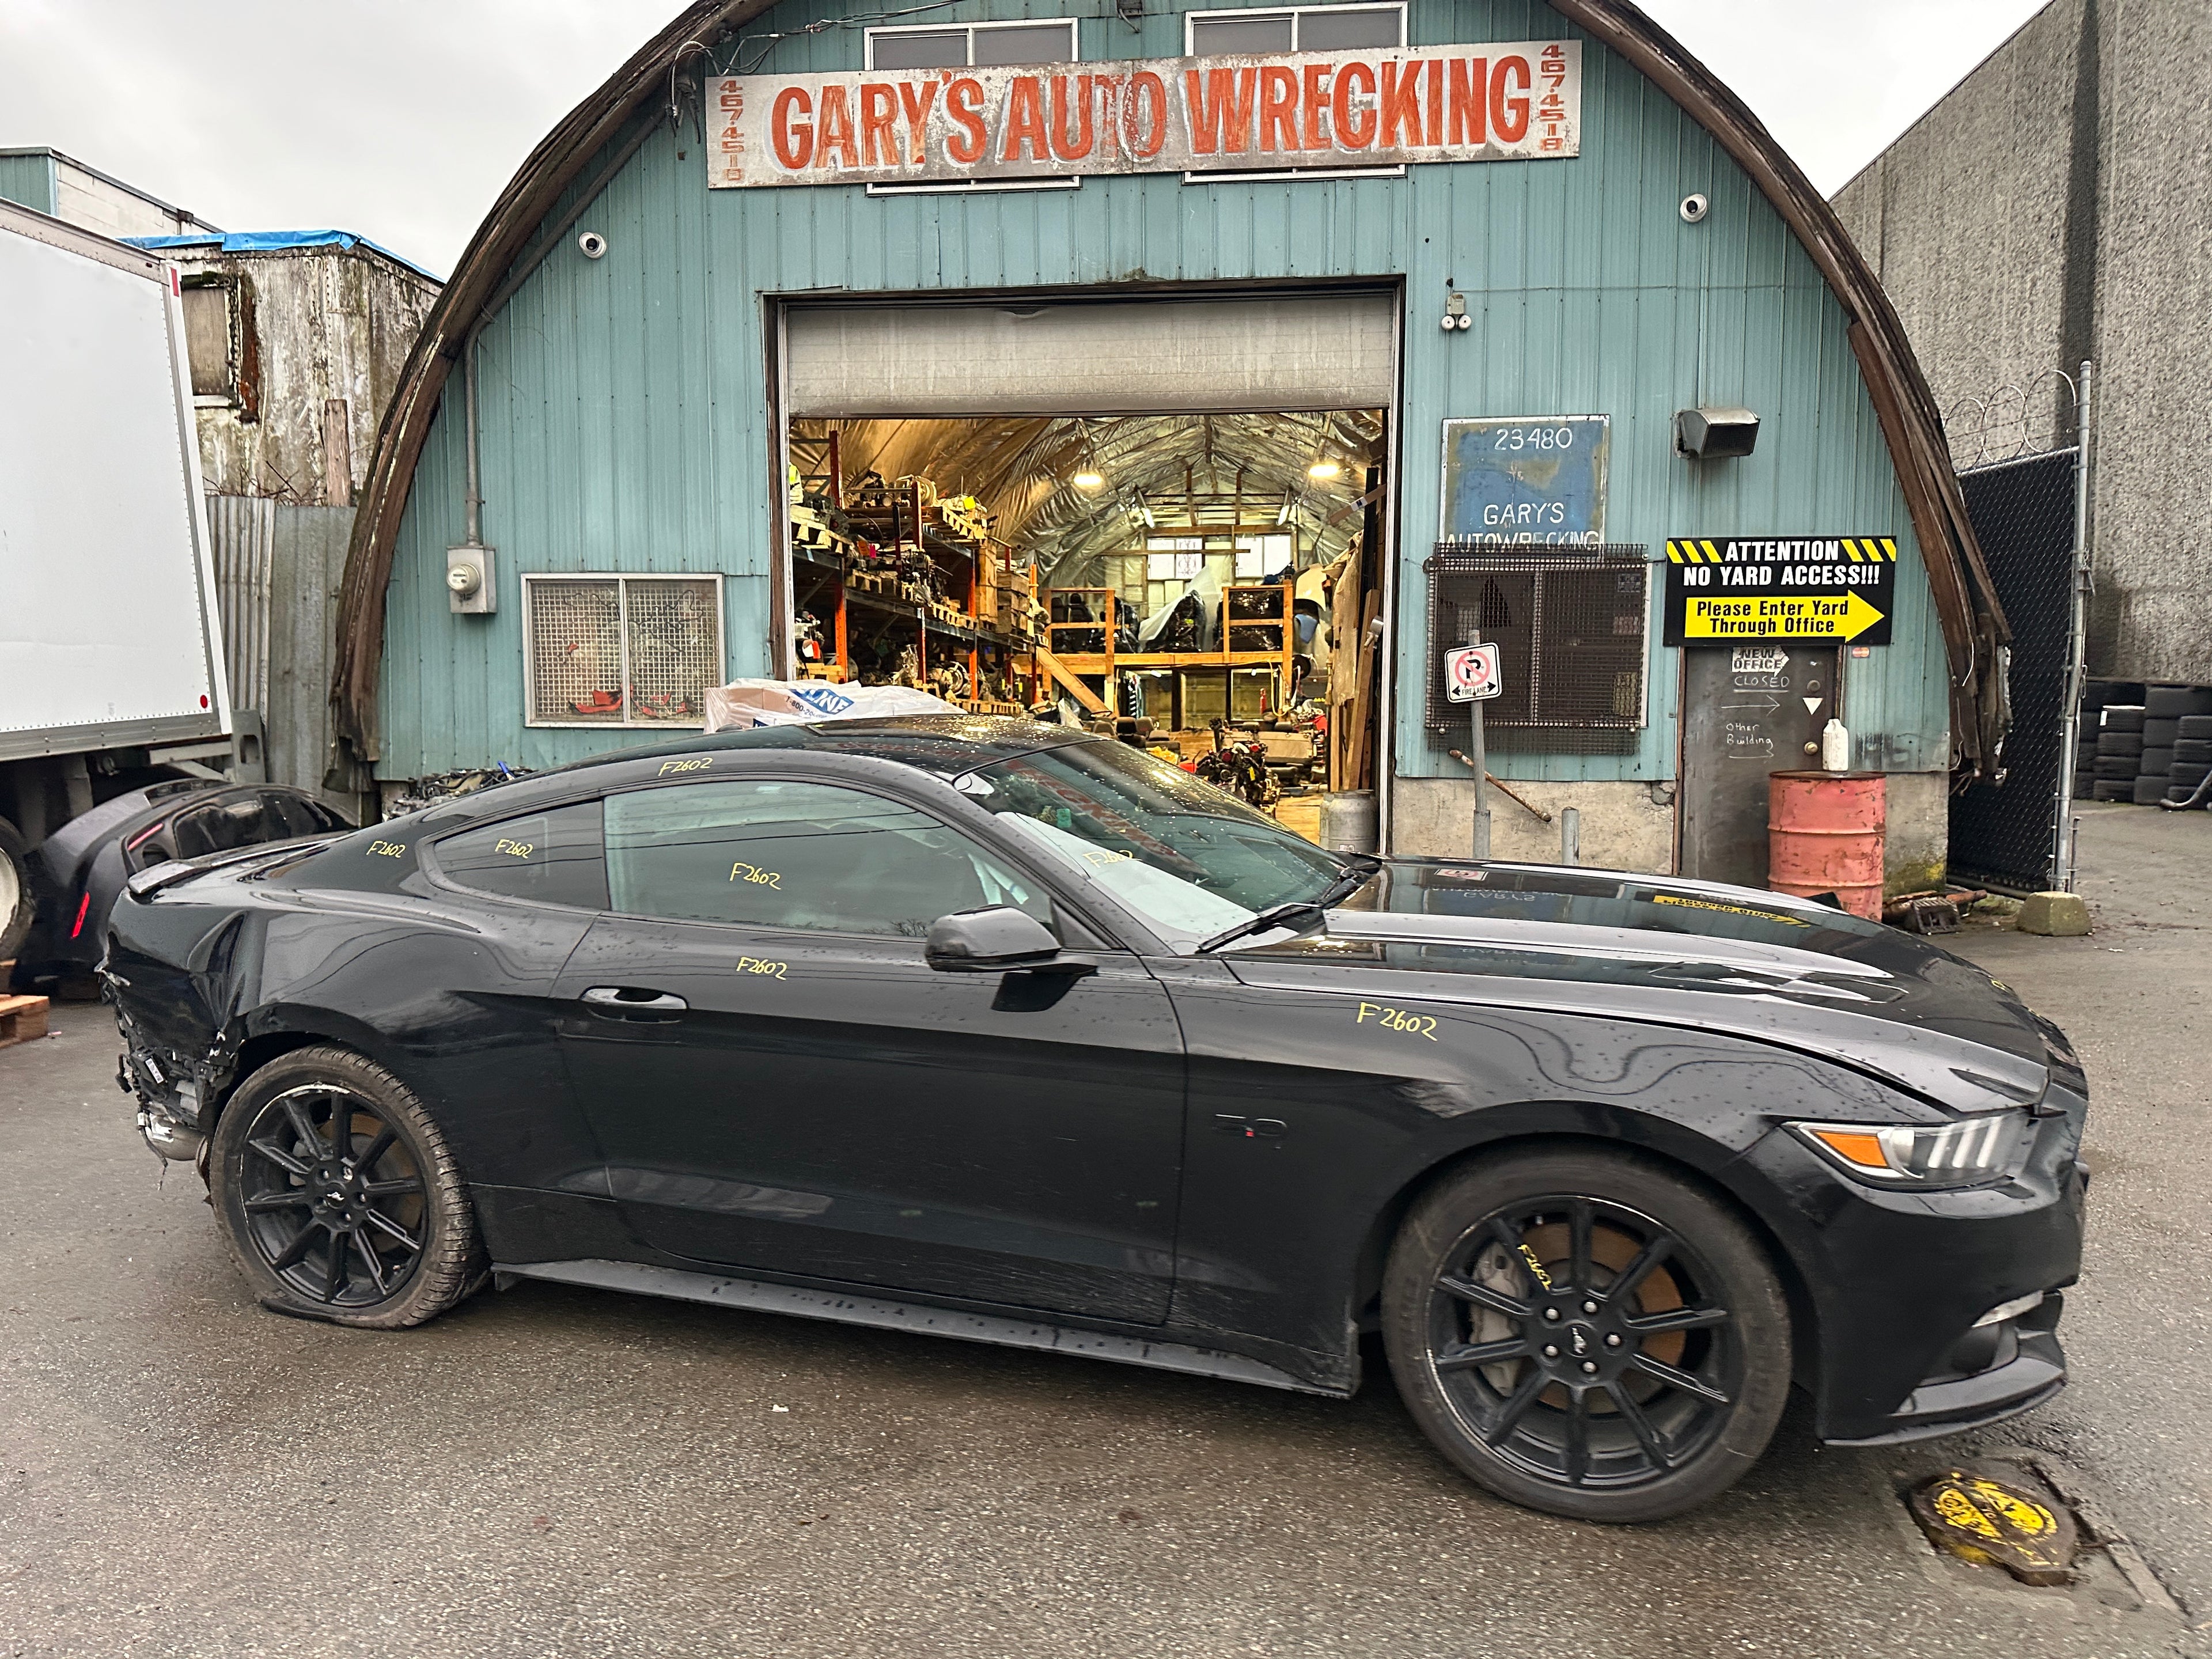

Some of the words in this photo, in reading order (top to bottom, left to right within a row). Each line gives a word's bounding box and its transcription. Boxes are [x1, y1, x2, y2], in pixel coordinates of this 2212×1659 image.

[770, 70, 987, 170] GARY'S
[1003, 70, 1168, 162] AUTO
[1185, 55, 1531, 154] WRECKING
[1494, 427, 1574, 450] 23480
[1483, 501, 1565, 525] GARY'S
[1724, 540, 1839, 562] ATTENTION
[1683, 566, 1711, 586] NO
[1719, 566, 1772, 586] YARD
[1781, 565, 1880, 585] ACCESS!!!
[1696, 601, 1751, 616] Please
[1759, 600, 1805, 616] Enter
[1812, 600, 1849, 616] Yard
[1710, 618, 1777, 635] Through
[1784, 617, 1835, 633] Office
[1740, 648, 1774, 658] NEW
[1734, 658, 1783, 669] OFFICE
[1734, 675, 1790, 688] CLOSED
[1461, 688, 1472, 696] FIRE
[1726, 722, 1760, 731] Other
[1726, 733, 1774, 751] Building
[658, 757, 714, 777] F2602
[366, 840, 406, 859] F2602
[495, 838, 533, 859] F2602
[1082, 849, 1142, 868] F2602
[729, 862, 782, 891] F2602
[736, 956, 788, 980] F2602
[1356, 1001, 1438, 1041] F2602
